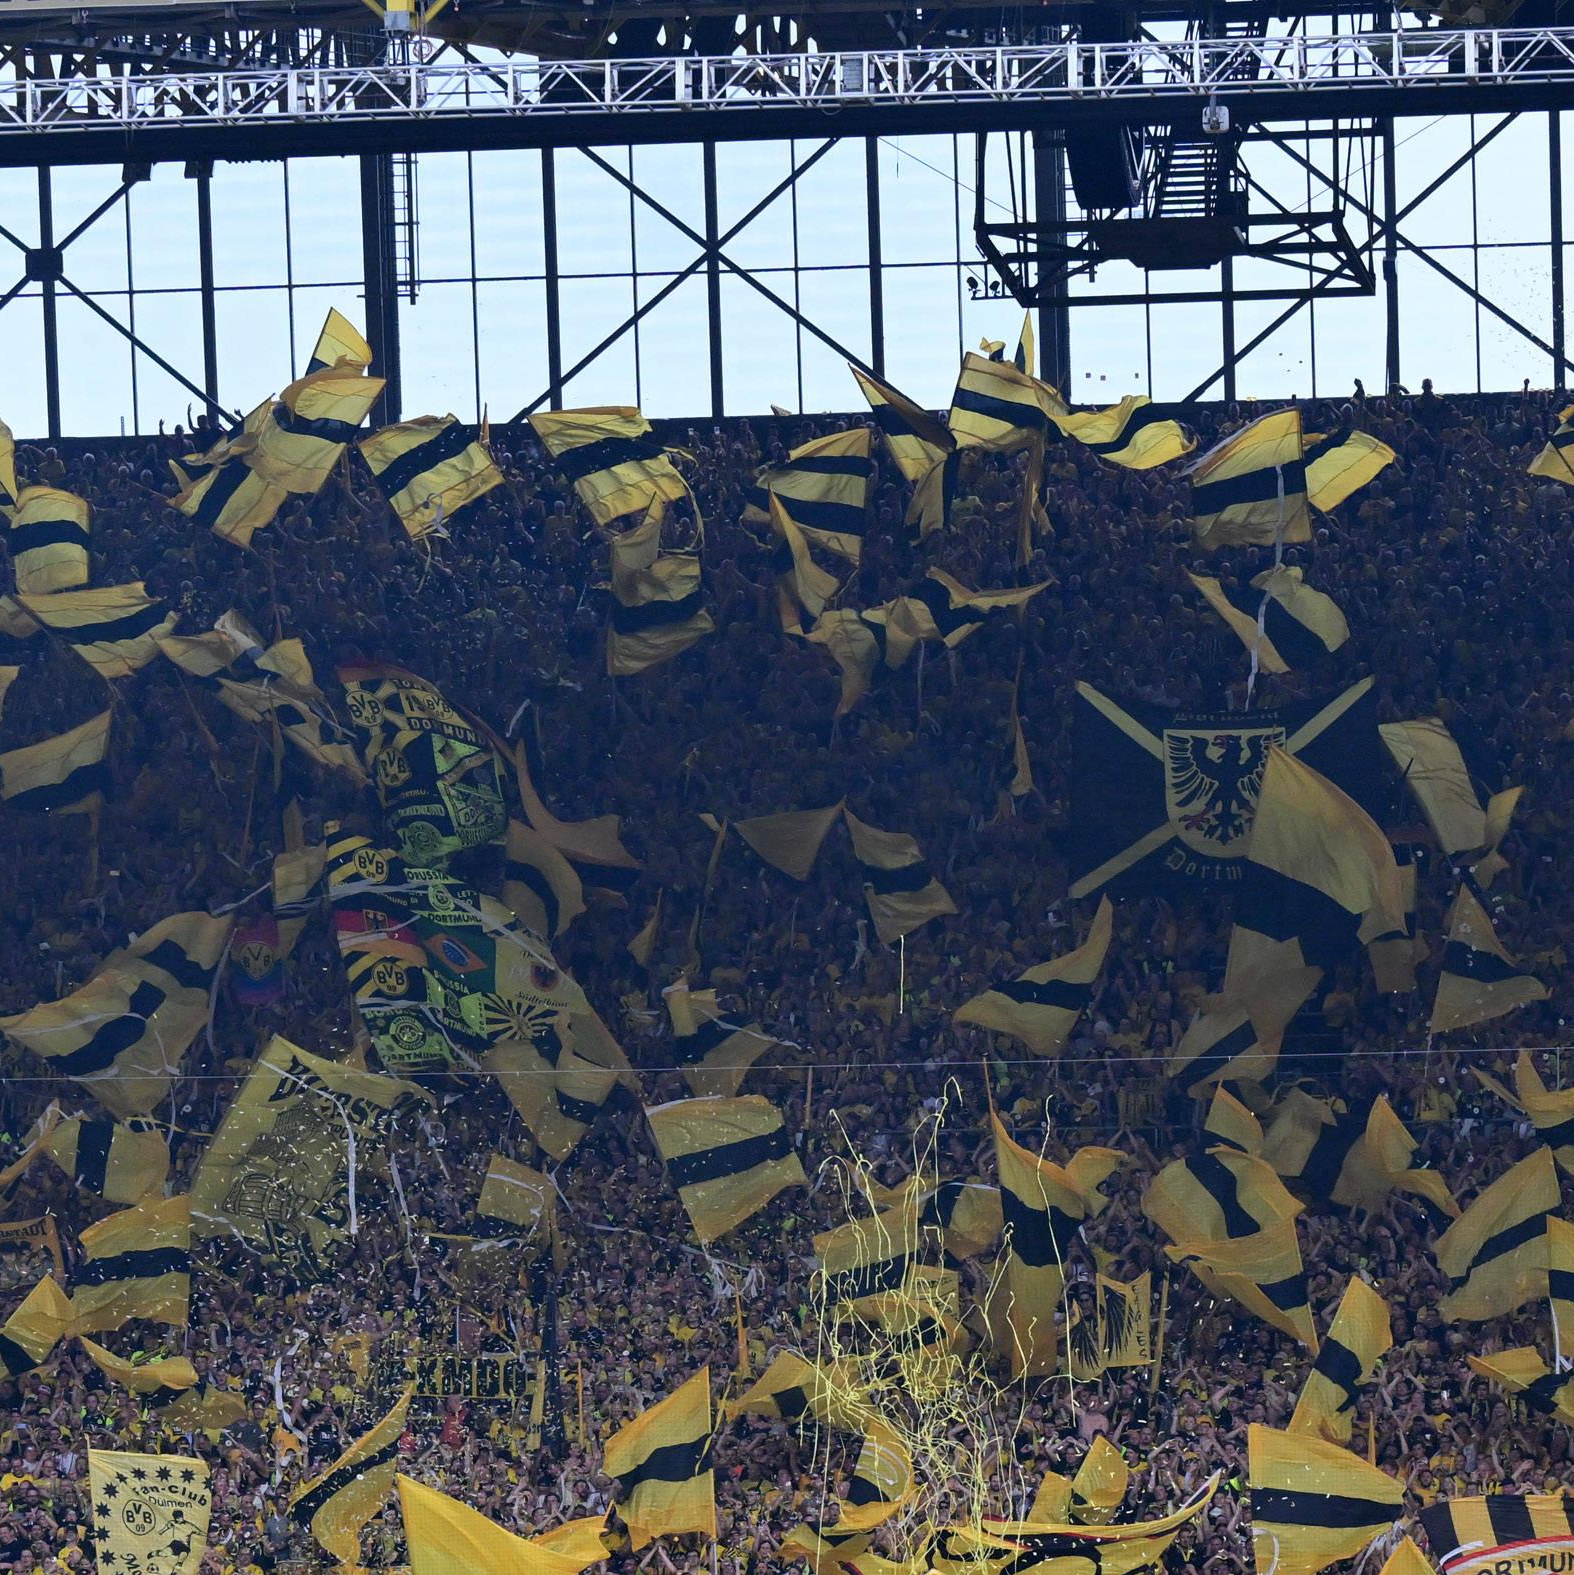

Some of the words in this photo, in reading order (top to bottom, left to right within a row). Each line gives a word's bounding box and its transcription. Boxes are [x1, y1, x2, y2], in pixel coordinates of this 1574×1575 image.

[351, 694, 380, 718] BVB
[410, 719, 491, 745] DOMUND
[358, 850, 386, 877] BVB
[1165, 848, 1243, 880] Dortm
[408, 870, 449, 881] ORUSSIA
[376, 964, 406, 986] BVB
[126, 1503, 153, 1523] BVB
[136, 1524, 146, 1532] 09
